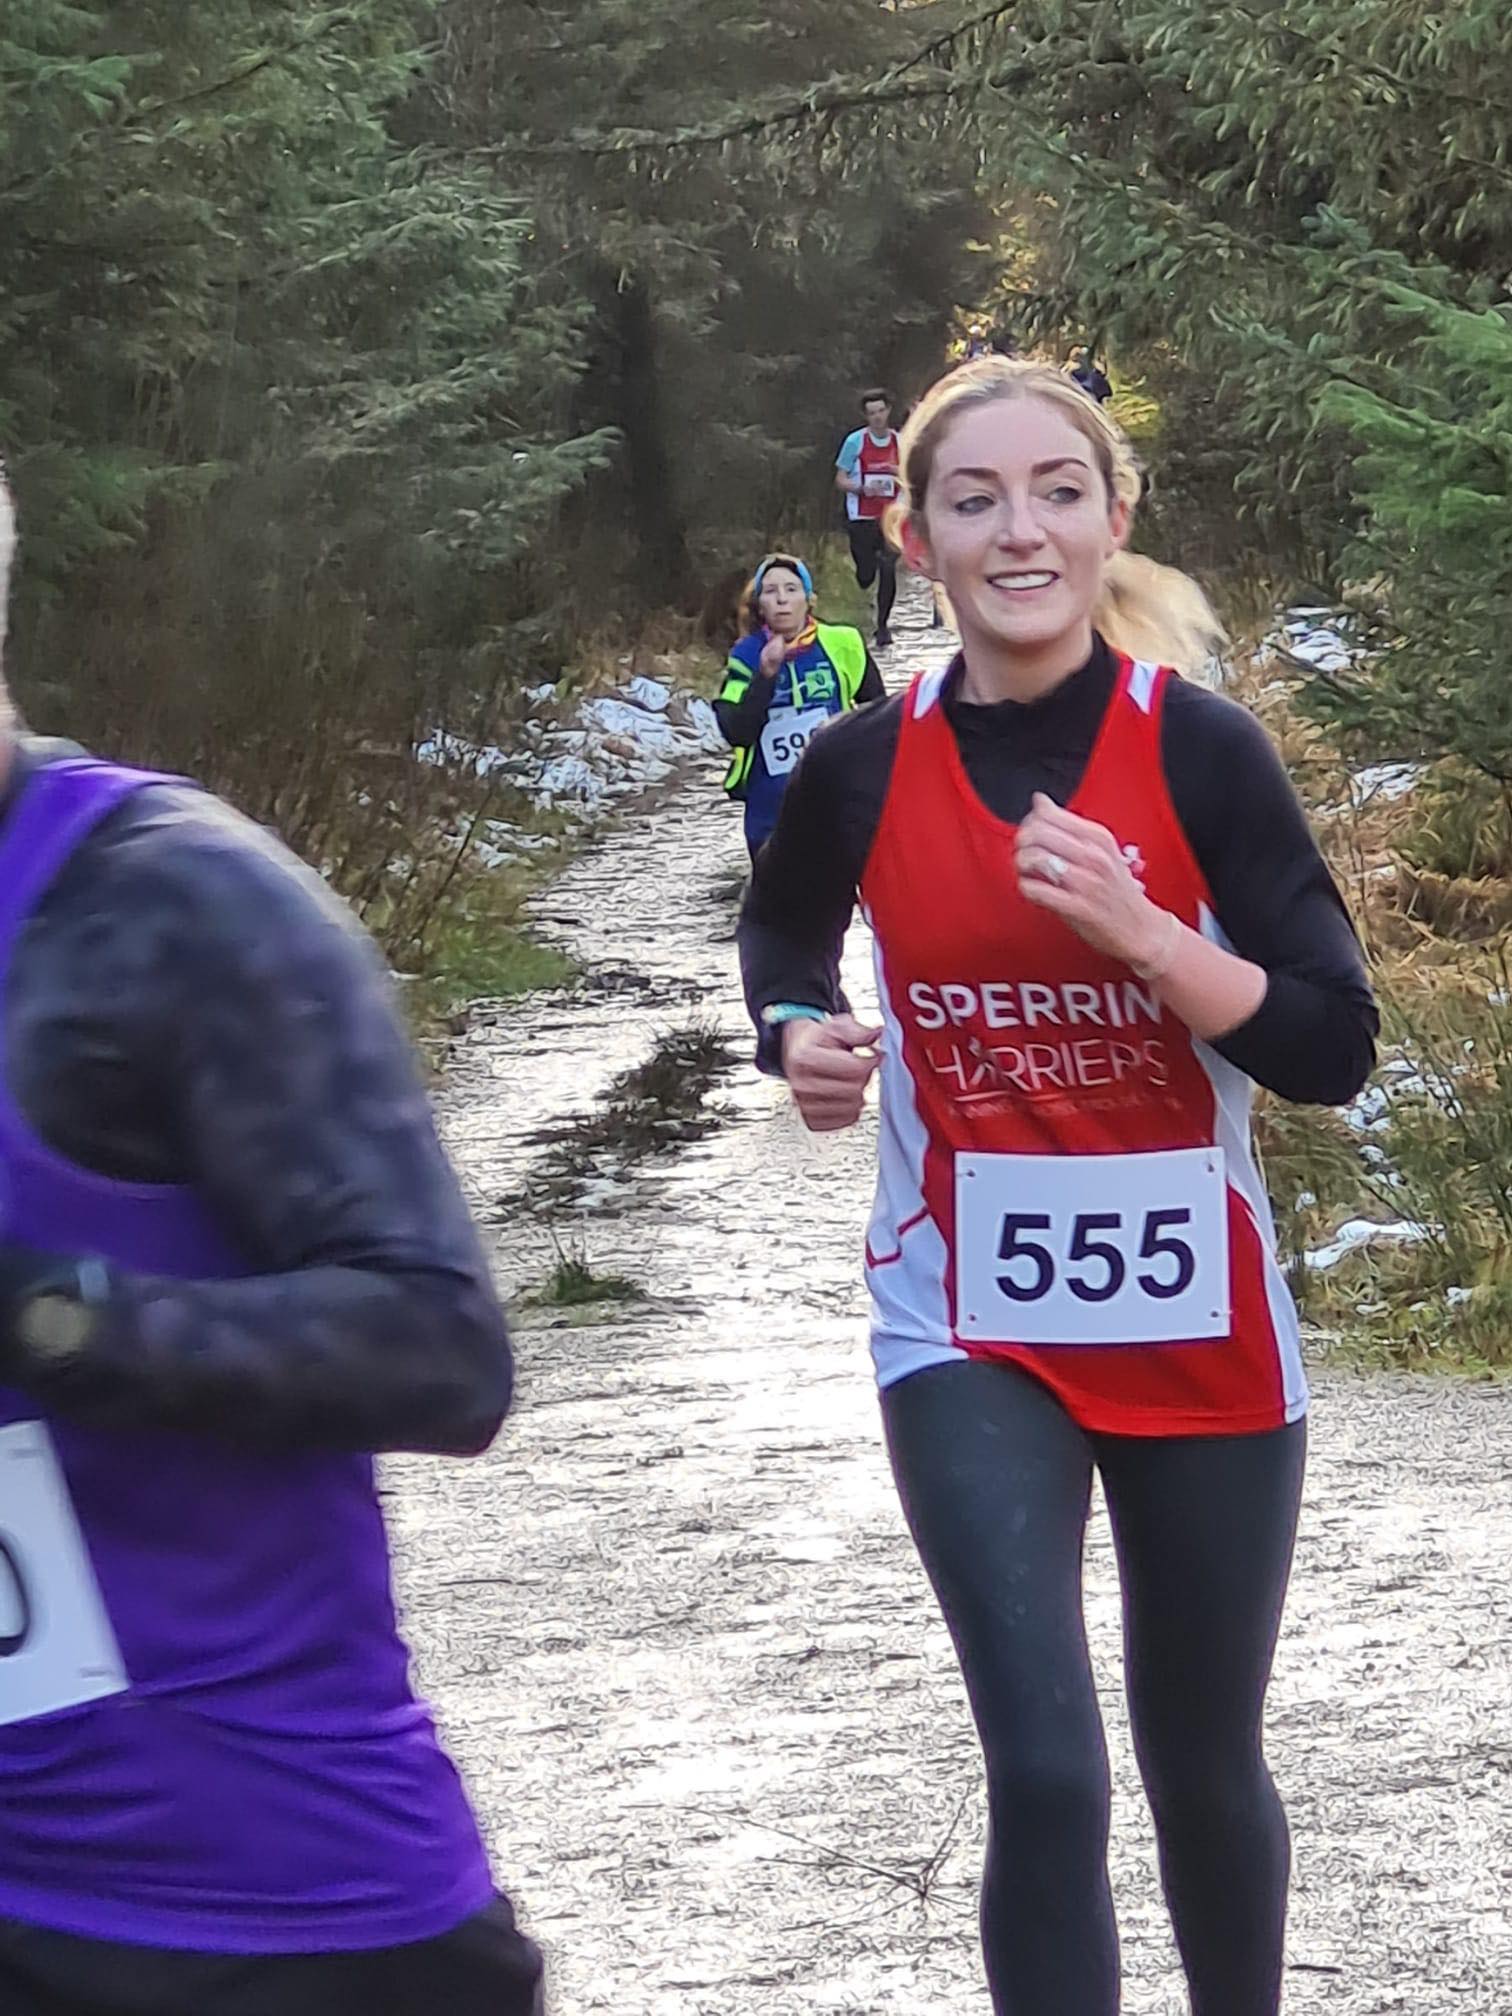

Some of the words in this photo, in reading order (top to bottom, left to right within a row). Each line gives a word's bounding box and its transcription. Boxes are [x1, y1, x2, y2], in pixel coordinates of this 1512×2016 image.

[772, 728, 818, 761] 59
[908, 981, 1162, 1029] SPERRIN
[995, 1207, 1195, 1302] 555
